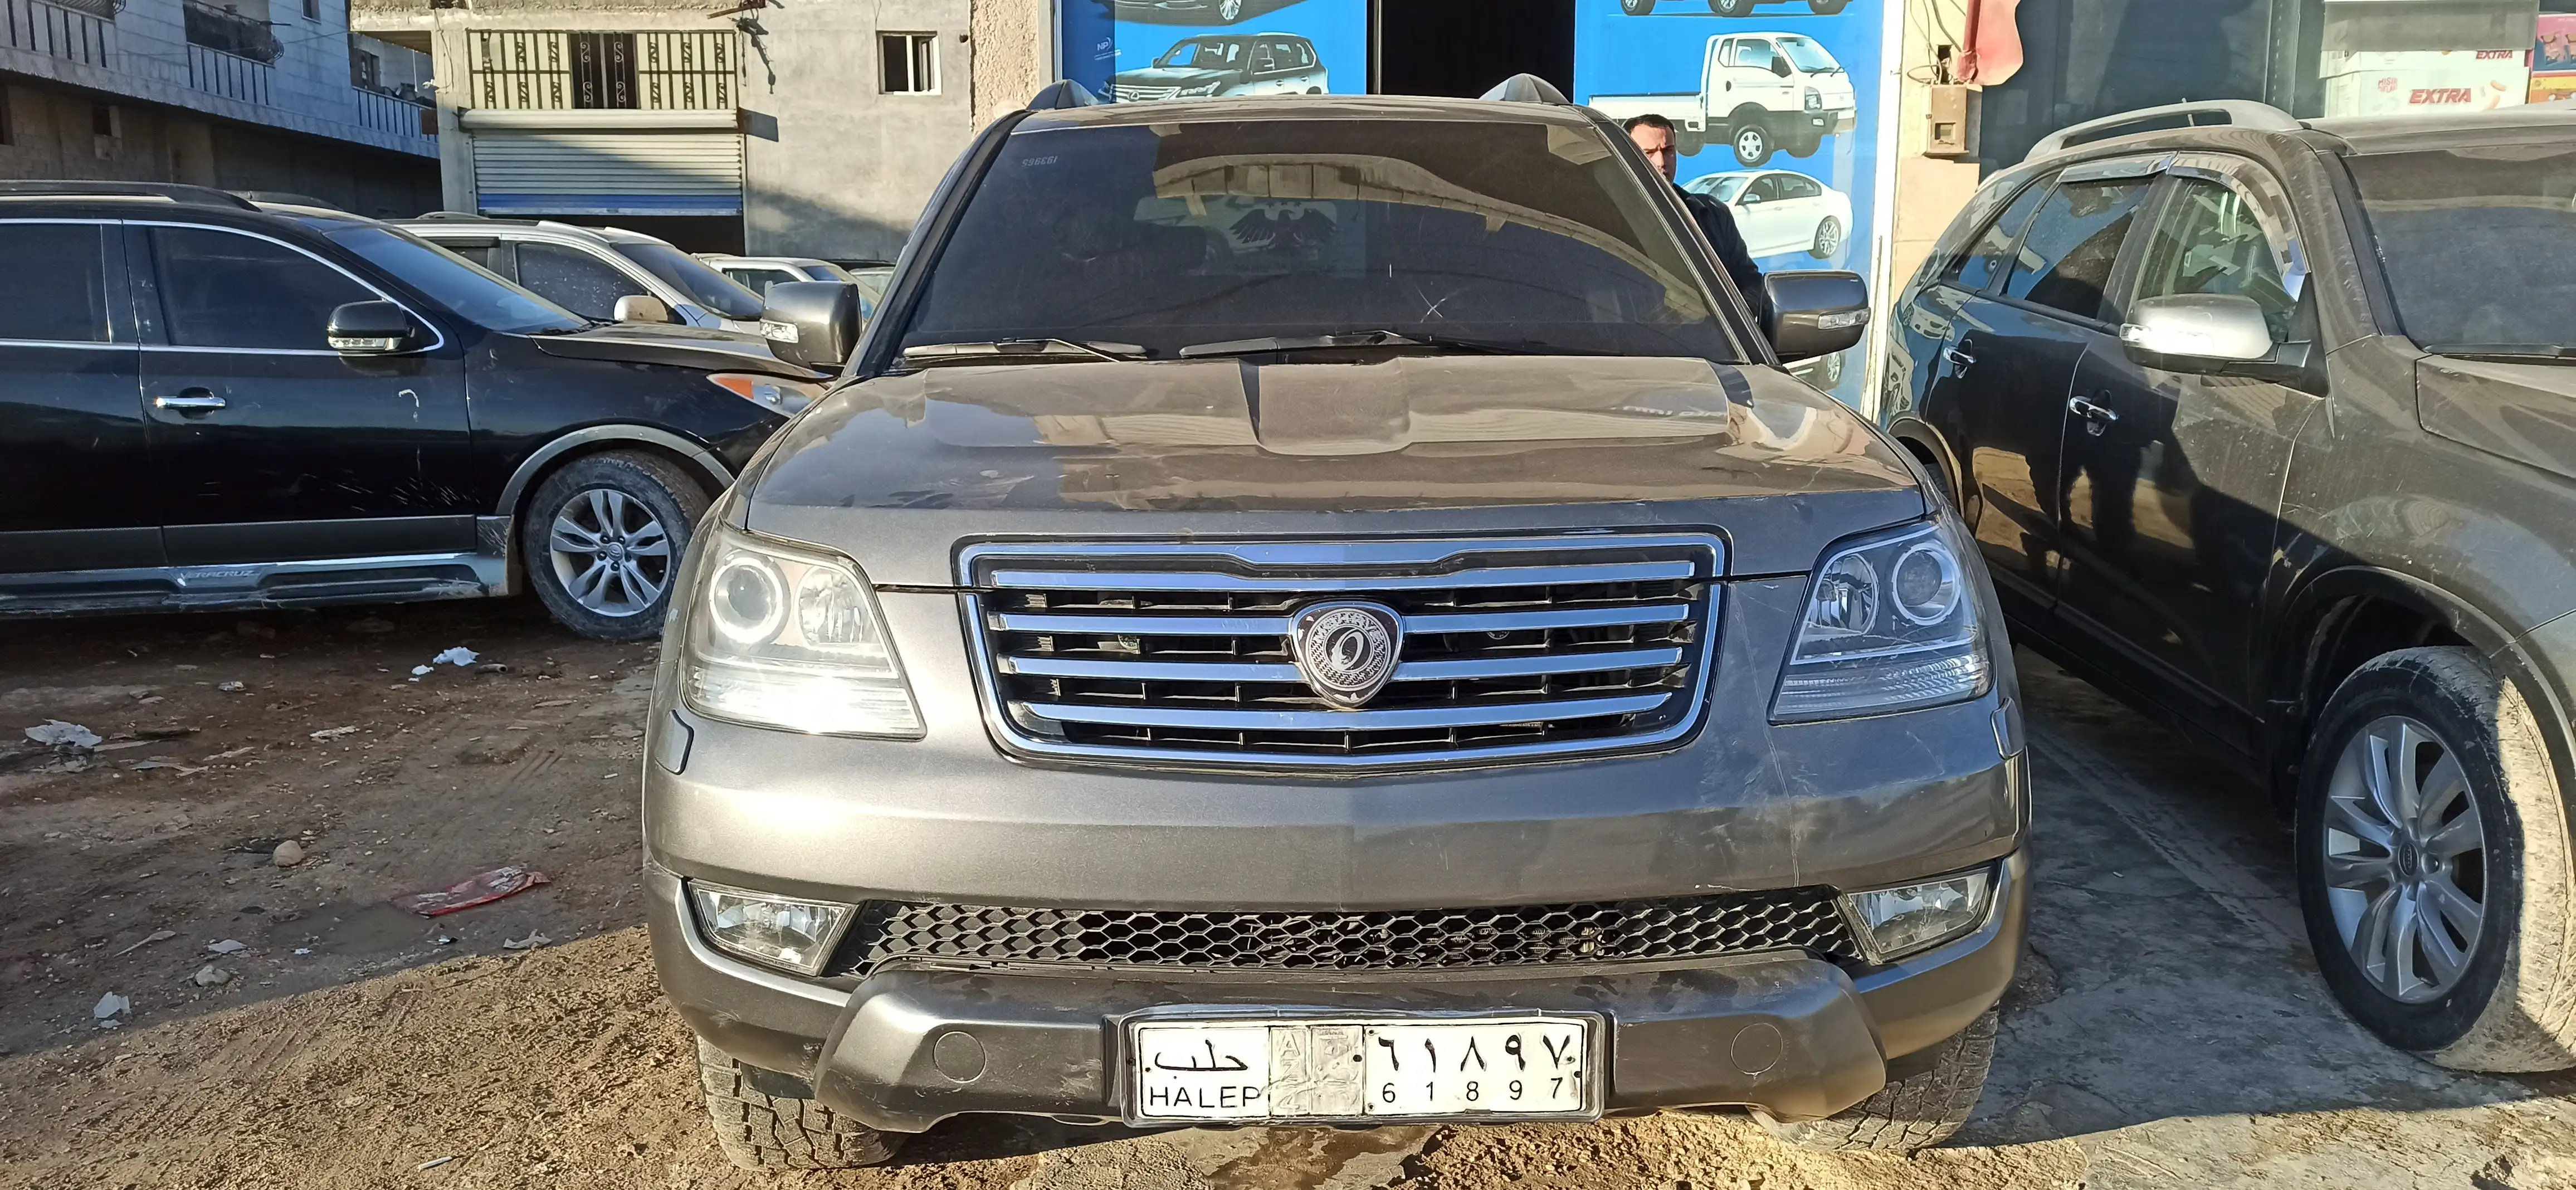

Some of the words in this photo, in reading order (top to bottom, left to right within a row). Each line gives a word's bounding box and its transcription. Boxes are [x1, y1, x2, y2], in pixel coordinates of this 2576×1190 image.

[2476, 50, 2513, 59] EXTRA
[2409, 88, 2471, 104] EXTRA
[180, 570, 255, 580] VERACRUZ
[1154, 1039, 1248, 1080] حلب
[1150, 1086, 1261, 1108] HALEP
